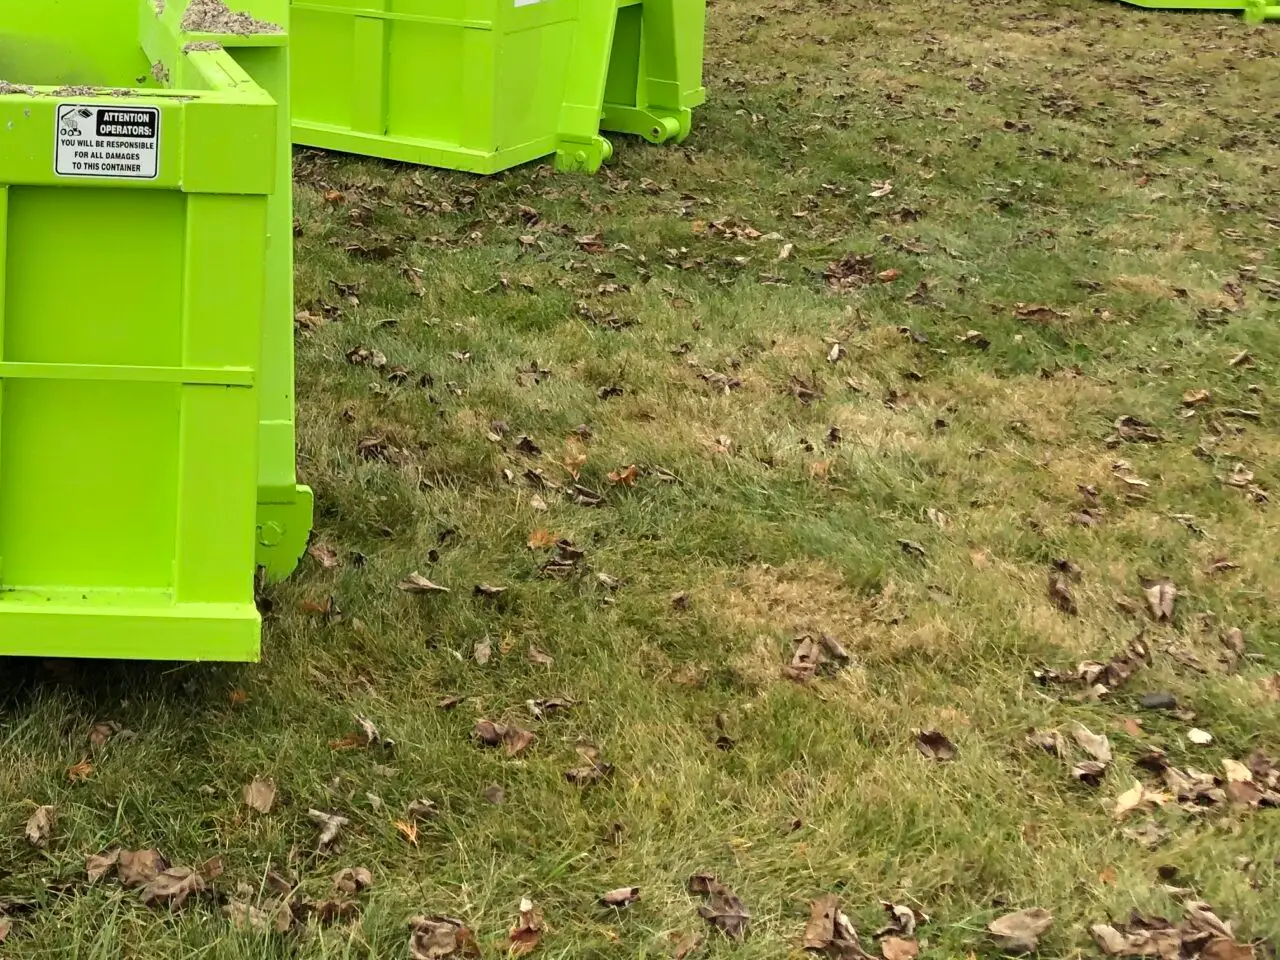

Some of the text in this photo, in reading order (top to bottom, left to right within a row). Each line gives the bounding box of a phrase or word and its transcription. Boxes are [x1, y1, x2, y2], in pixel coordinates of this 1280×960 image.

[103, 112, 150, 123] ATTENTION
[100, 125, 152, 136] OPERATORS:
[106, 141, 154, 149] RESPONSIBLE
[105, 152, 140, 160] DAMAGES
[72, 162, 141, 172] TO THIS CONTAINER
